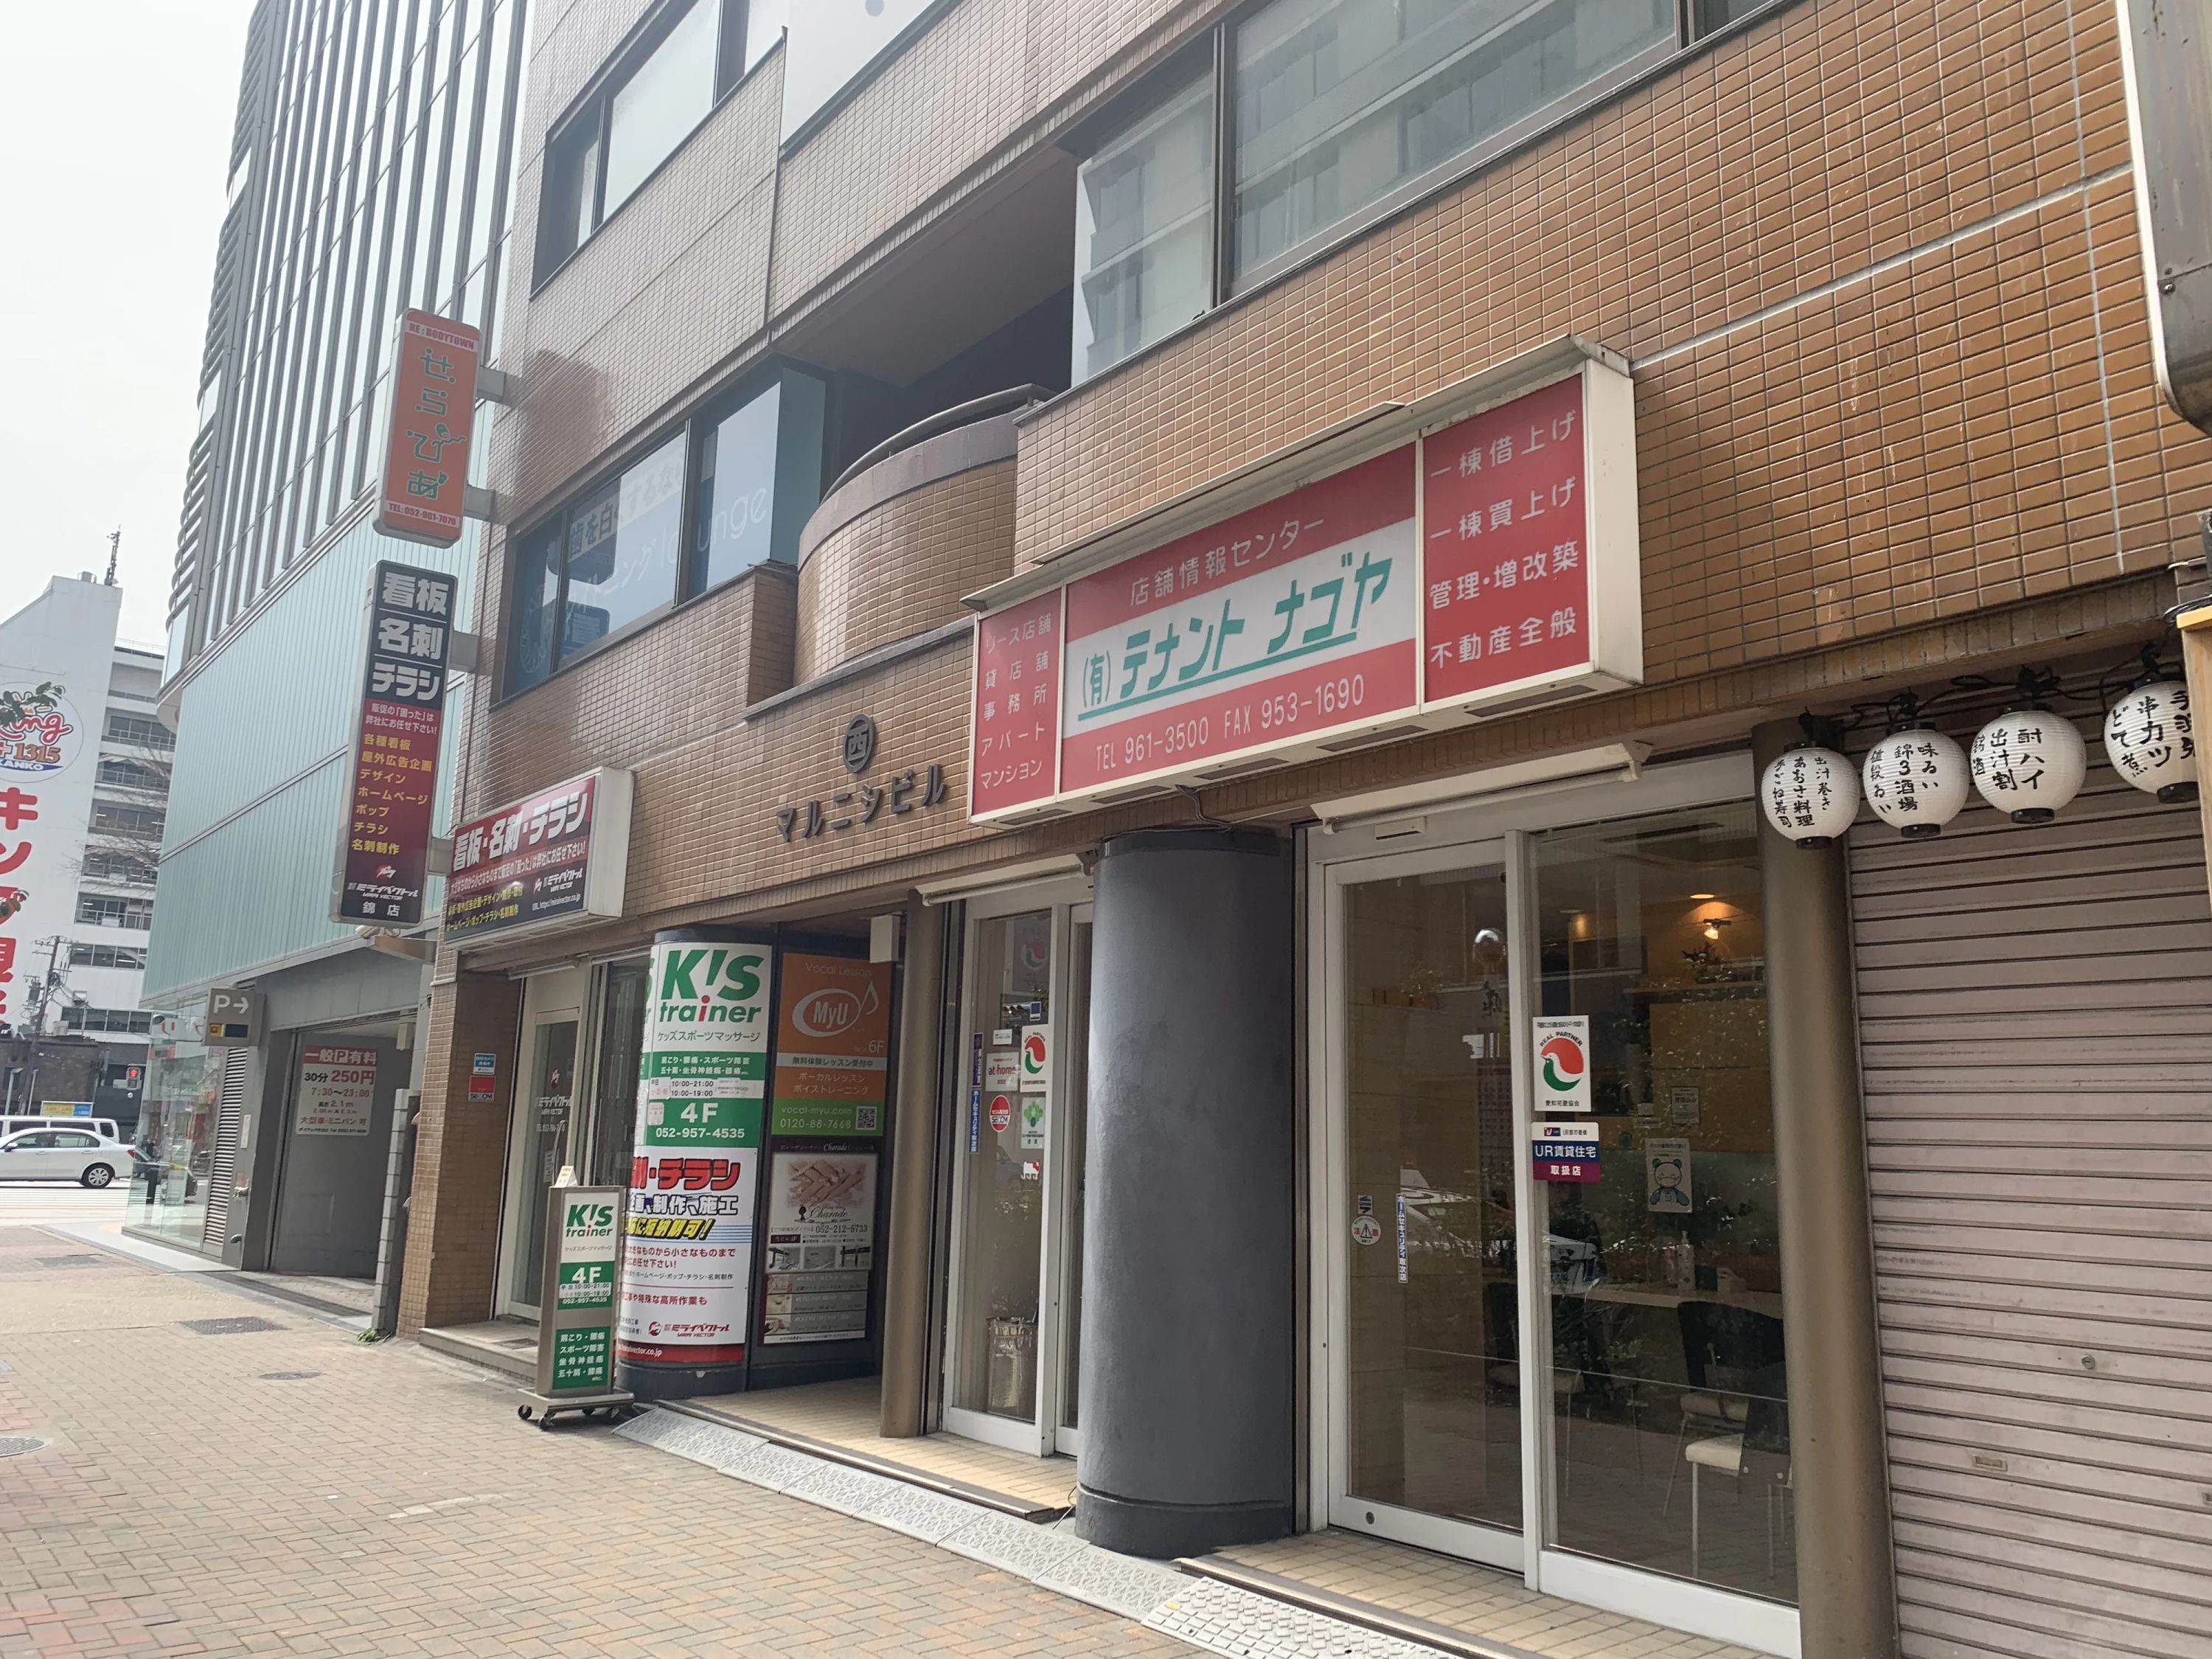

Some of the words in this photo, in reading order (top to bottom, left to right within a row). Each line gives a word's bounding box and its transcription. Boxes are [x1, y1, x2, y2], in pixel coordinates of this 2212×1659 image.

[1430, 409, 1576, 478] 一棟借上げ
[1430, 475, 1576, 540] 一棟買上げ
[1130, 518, 1324, 606] 店舗情報センター
[1430, 539, 1578, 610] 管理・増改築
[382, 571, 449, 616] 看板
[1267, 552, 1393, 655] ナゴヤ
[378, 617, 444, 660] 名刺
[1430, 606, 1576, 669] 不動産全般
[372, 662, 440, 701] チラシ
[1096, 745, 1116, 771] TEL
[1125, 715, 1209, 764] 961-3500
[1224, 704, 1251, 738] FAX
[1262, 673, 1364, 729] 953-1690
[2137, 695, 2171, 768] 串カツ
[13, 742, 61, 764] 1315
[981, 721, 1045, 757] アパート
[361, 751, 433, 772] 屋外広告企画
[2017, 728, 2045, 790] 酎ハイ
[360, 768, 406, 785] デザイン
[981, 759, 1043, 790] マンション
[358, 786, 428, 805] ホームページ
[777, 763, 946, 843] マルニシビル
[353, 821, 389, 835] チラシ
[213, 995, 230, 1014] P
[659, 995, 762, 1023] trainer
[813, 1001, 849, 1029] MyU
[869, 1040, 885, 1053] 6F
[304, 1072, 328, 1083] 30分
[330, 1069, 375, 1085] 250円
[680, 1102, 718, 1124] 4F
[655, 1127, 745, 1139] 052-957-4535
[1535, 1145, 1596, 1158] UR賃貸住宅
[1550, 1165, 1582, 1176] 取扱店
[566, 1224, 613, 1238] trainer
[571, 1267, 602, 1284] 4F
